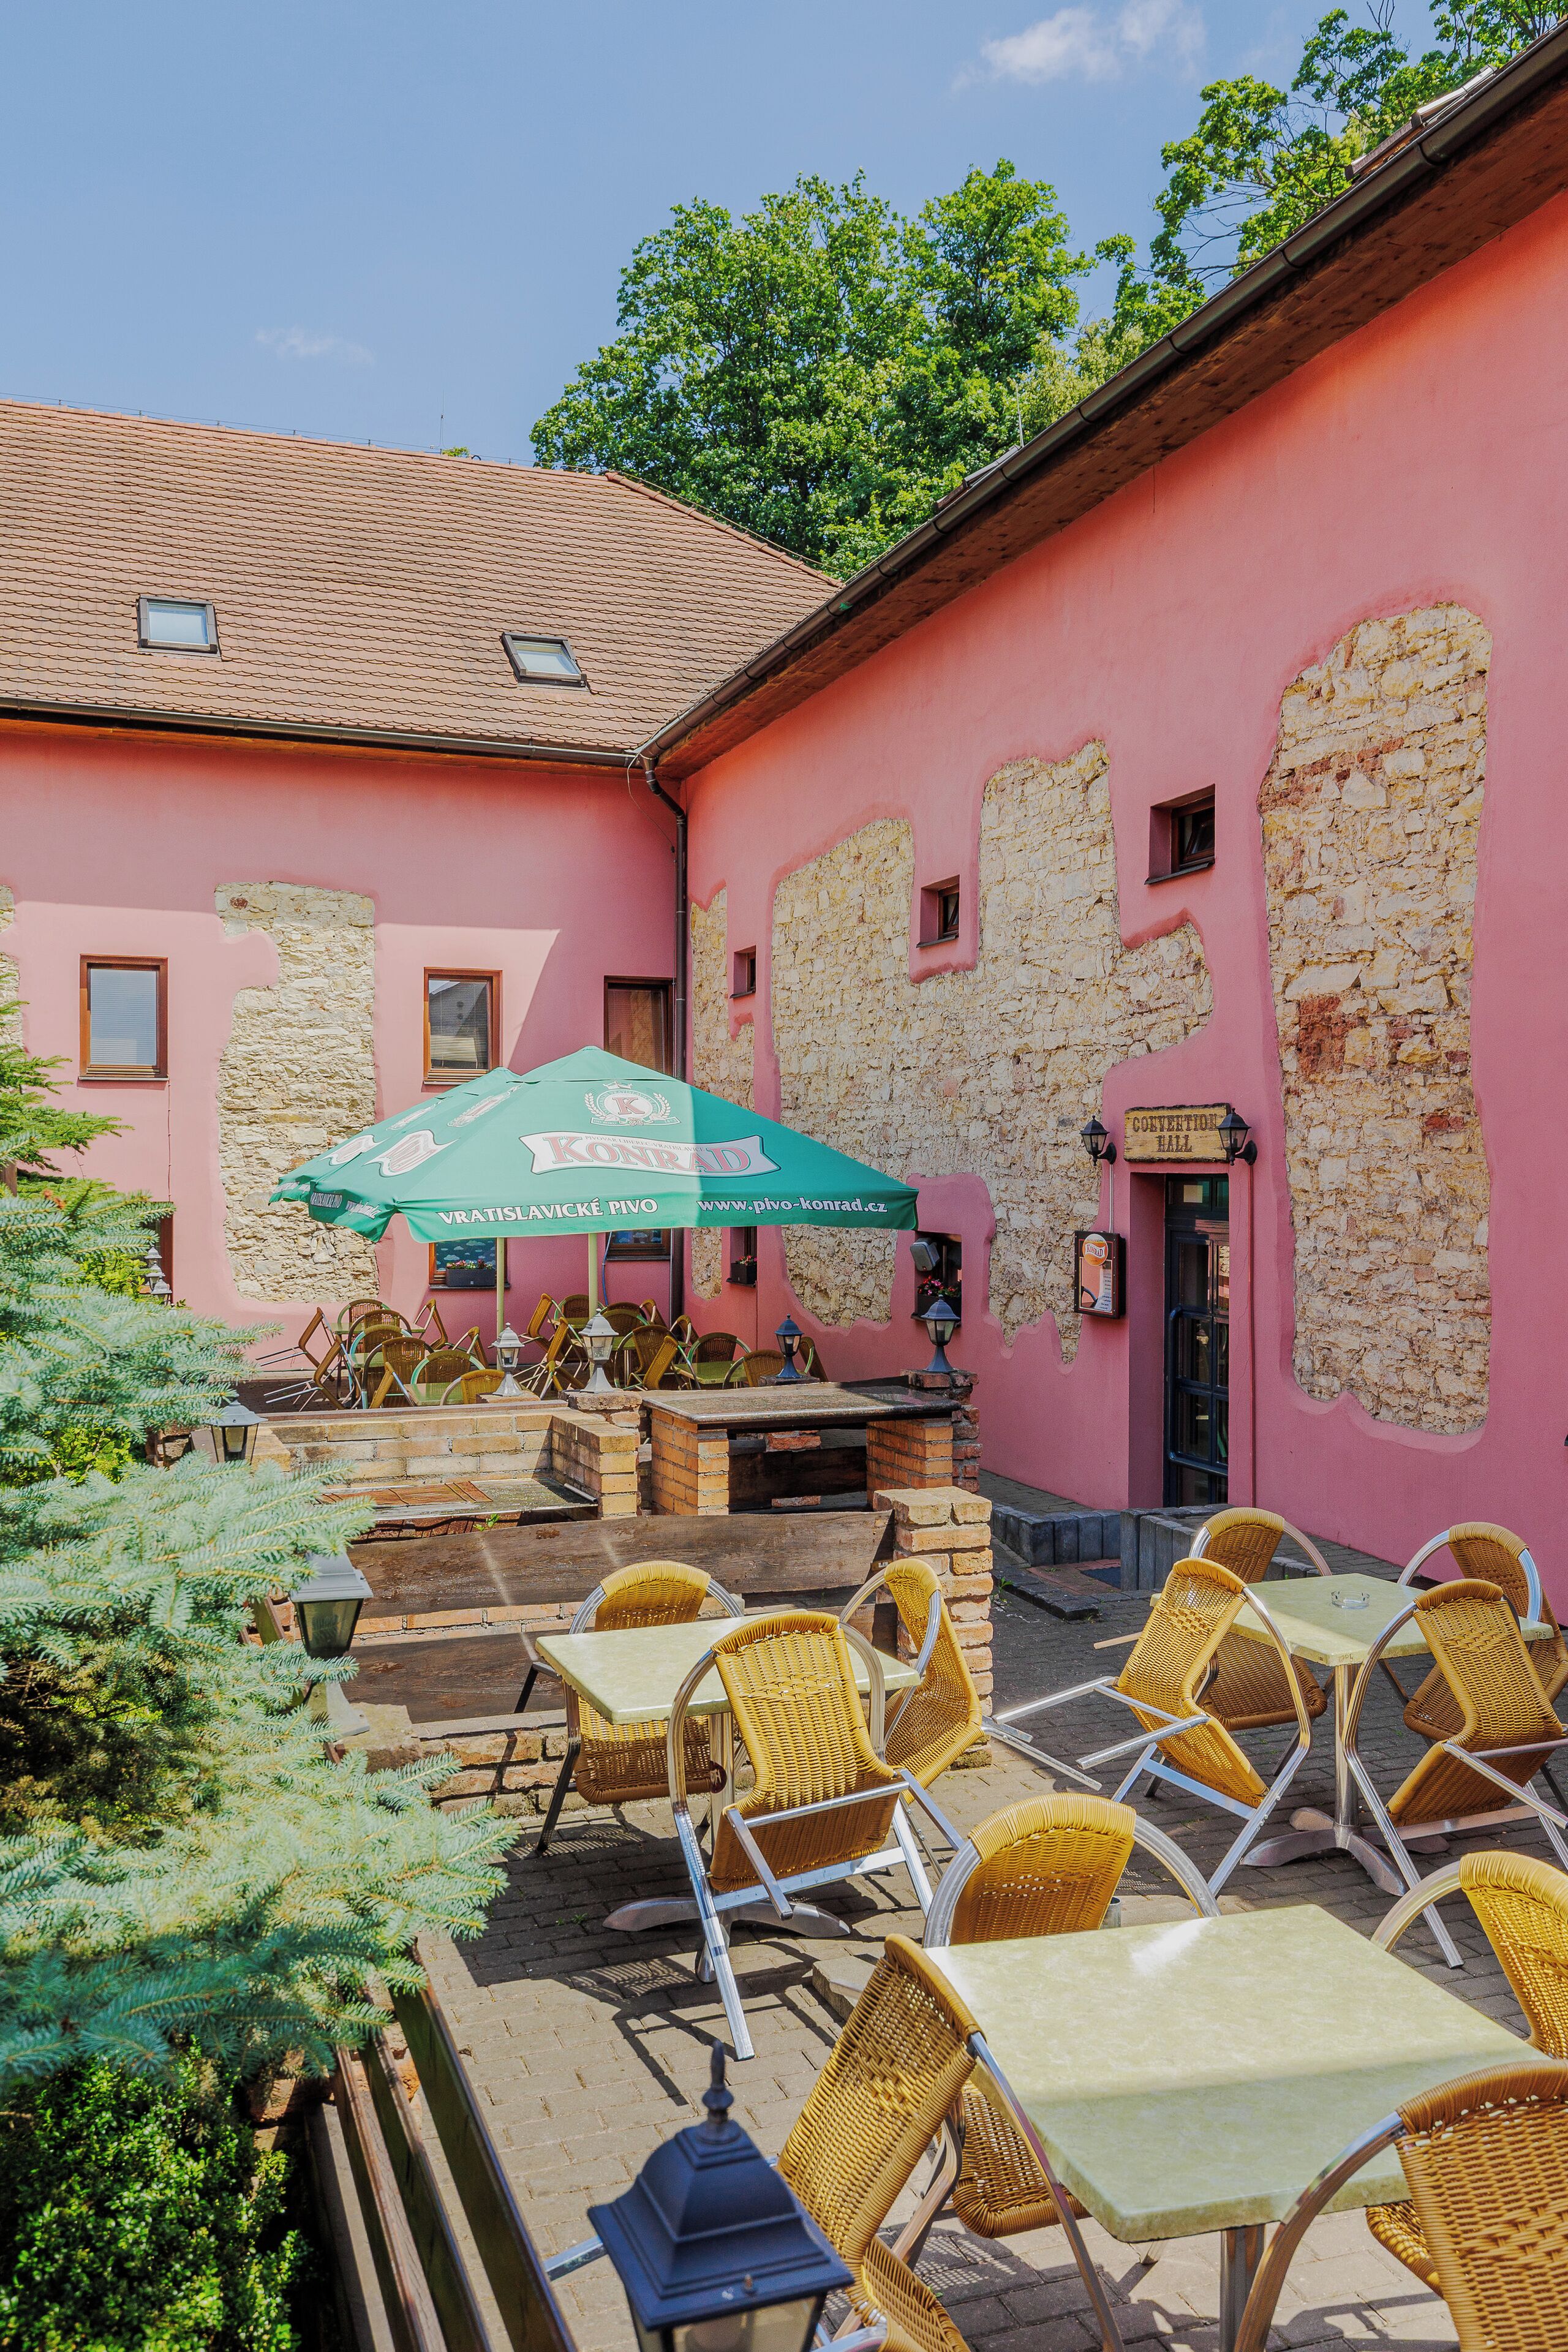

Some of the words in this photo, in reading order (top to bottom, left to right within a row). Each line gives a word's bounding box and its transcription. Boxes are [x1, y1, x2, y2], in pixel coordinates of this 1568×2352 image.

[1133, 1114, 1219, 1133] CONVENTION
[1156, 1134, 1193, 1153] HALL
[542, 1136, 752, 1173] KONRAD
[435, 1197, 604, 1225] VRATISLAVICKÉ
[605, 1198, 658, 1216] PIVO
[696, 1196, 888, 1215] www.pivo-konrad.cz
